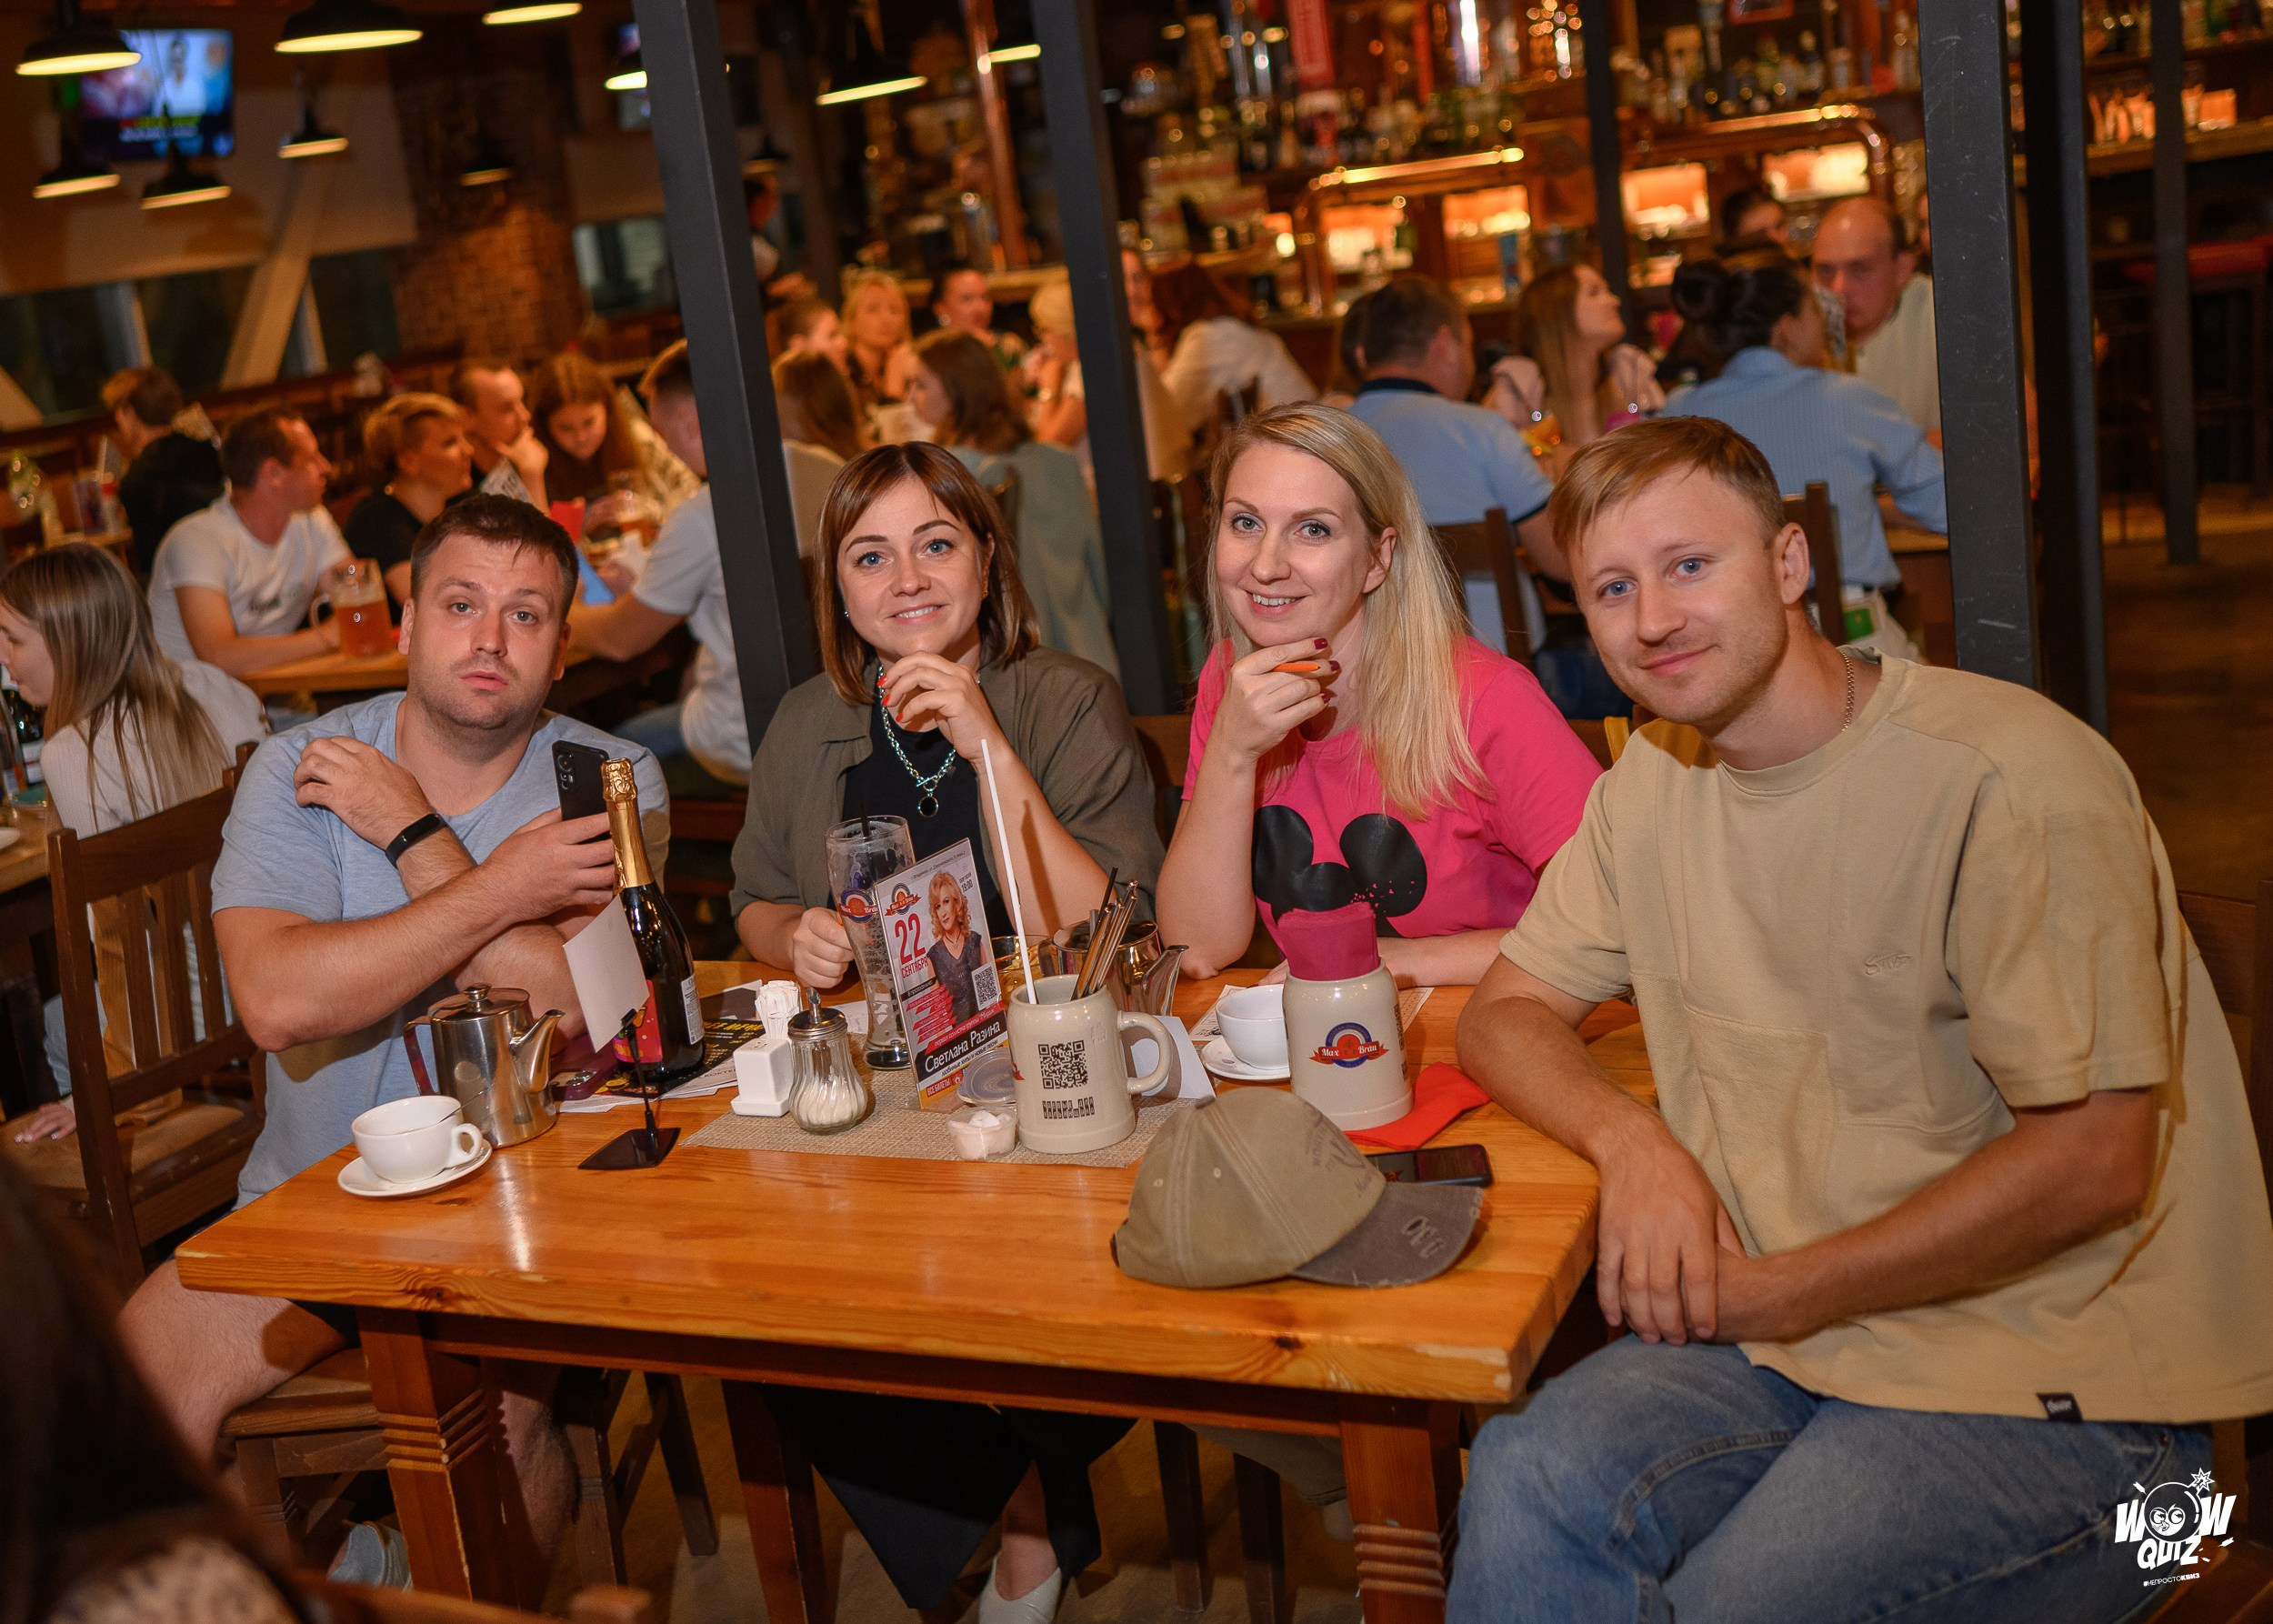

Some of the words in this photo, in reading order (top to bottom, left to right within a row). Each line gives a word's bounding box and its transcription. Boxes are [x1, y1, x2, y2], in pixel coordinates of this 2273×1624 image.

[895, 913, 926, 965] 22
[901, 956, 929, 978] СЕНТЯБРЯ
[926, 1040, 969, 1073] Светлана
[970, 1021, 1000, 1048] Разина
[1321, 1048, 1339, 1057] Max
[927, 1087, 936, 1096] ВСЕ
[935, 1078, 950, 1092] БИЛЕТЫ
